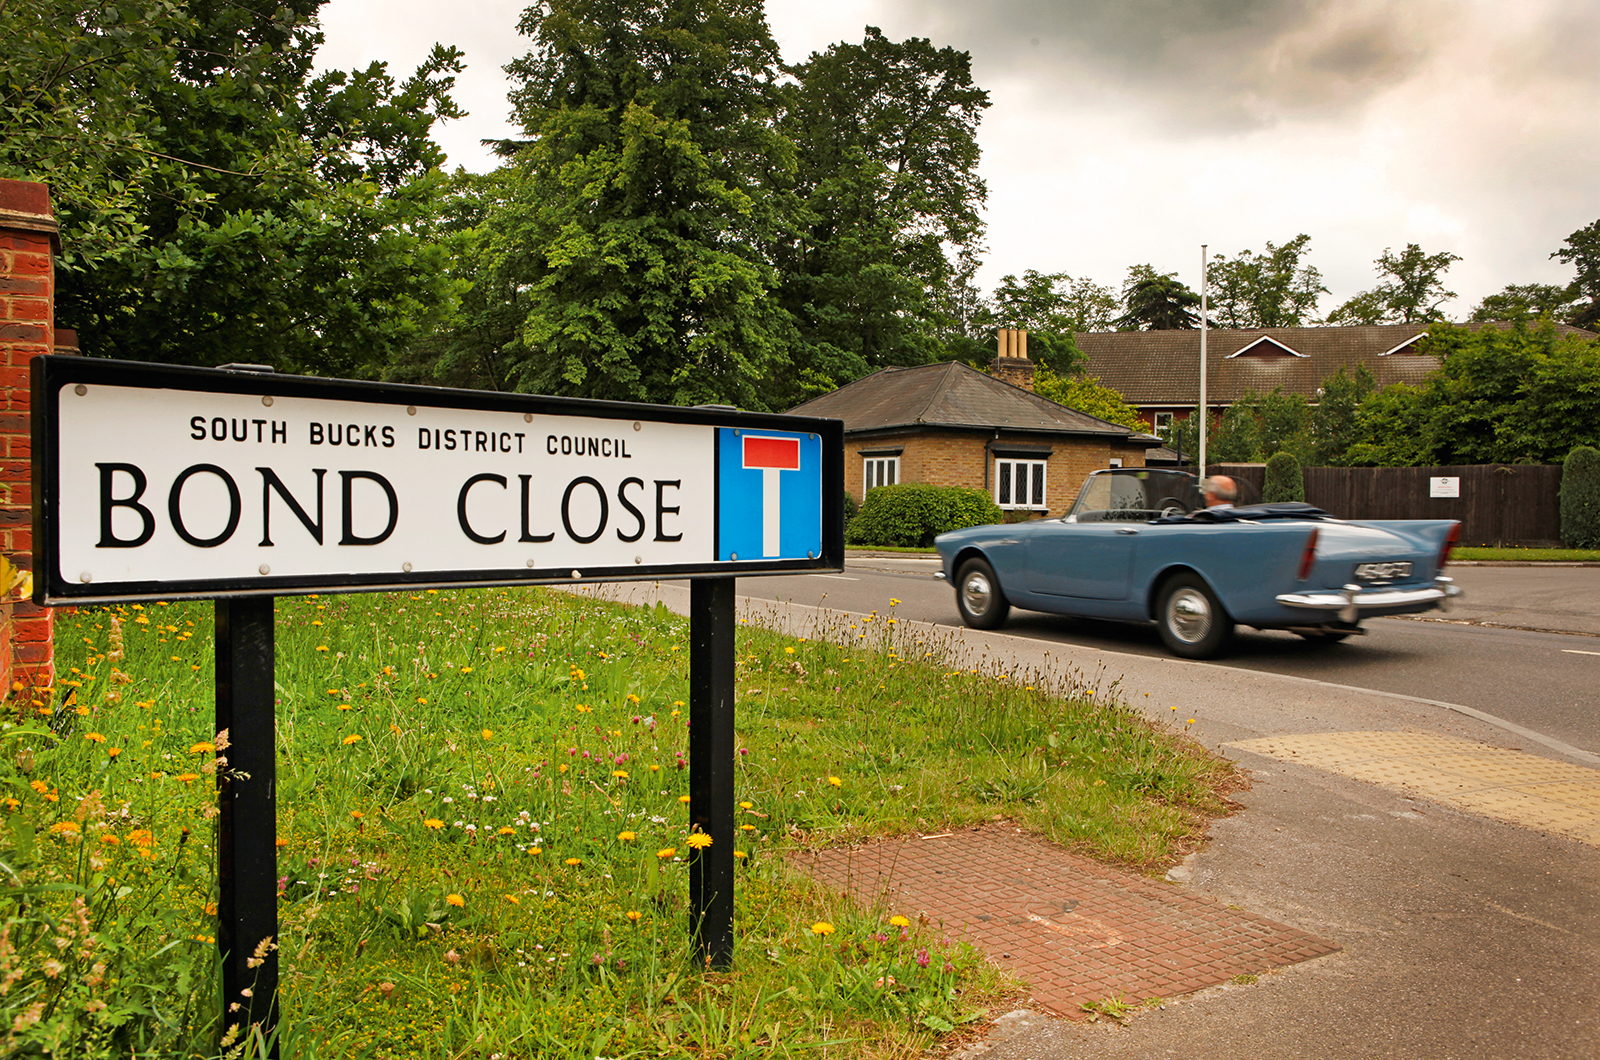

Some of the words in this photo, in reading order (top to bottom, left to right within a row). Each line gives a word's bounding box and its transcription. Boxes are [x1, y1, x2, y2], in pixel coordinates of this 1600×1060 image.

[191, 416, 286, 443] SOUTH
[310, 423, 394, 447] BUCKS
[419, 428, 525, 453] DISTRICT
[547, 435, 631, 458] COUNCIL
[95, 463, 398, 548] BOND
[457, 473, 682, 545] CLOSE
